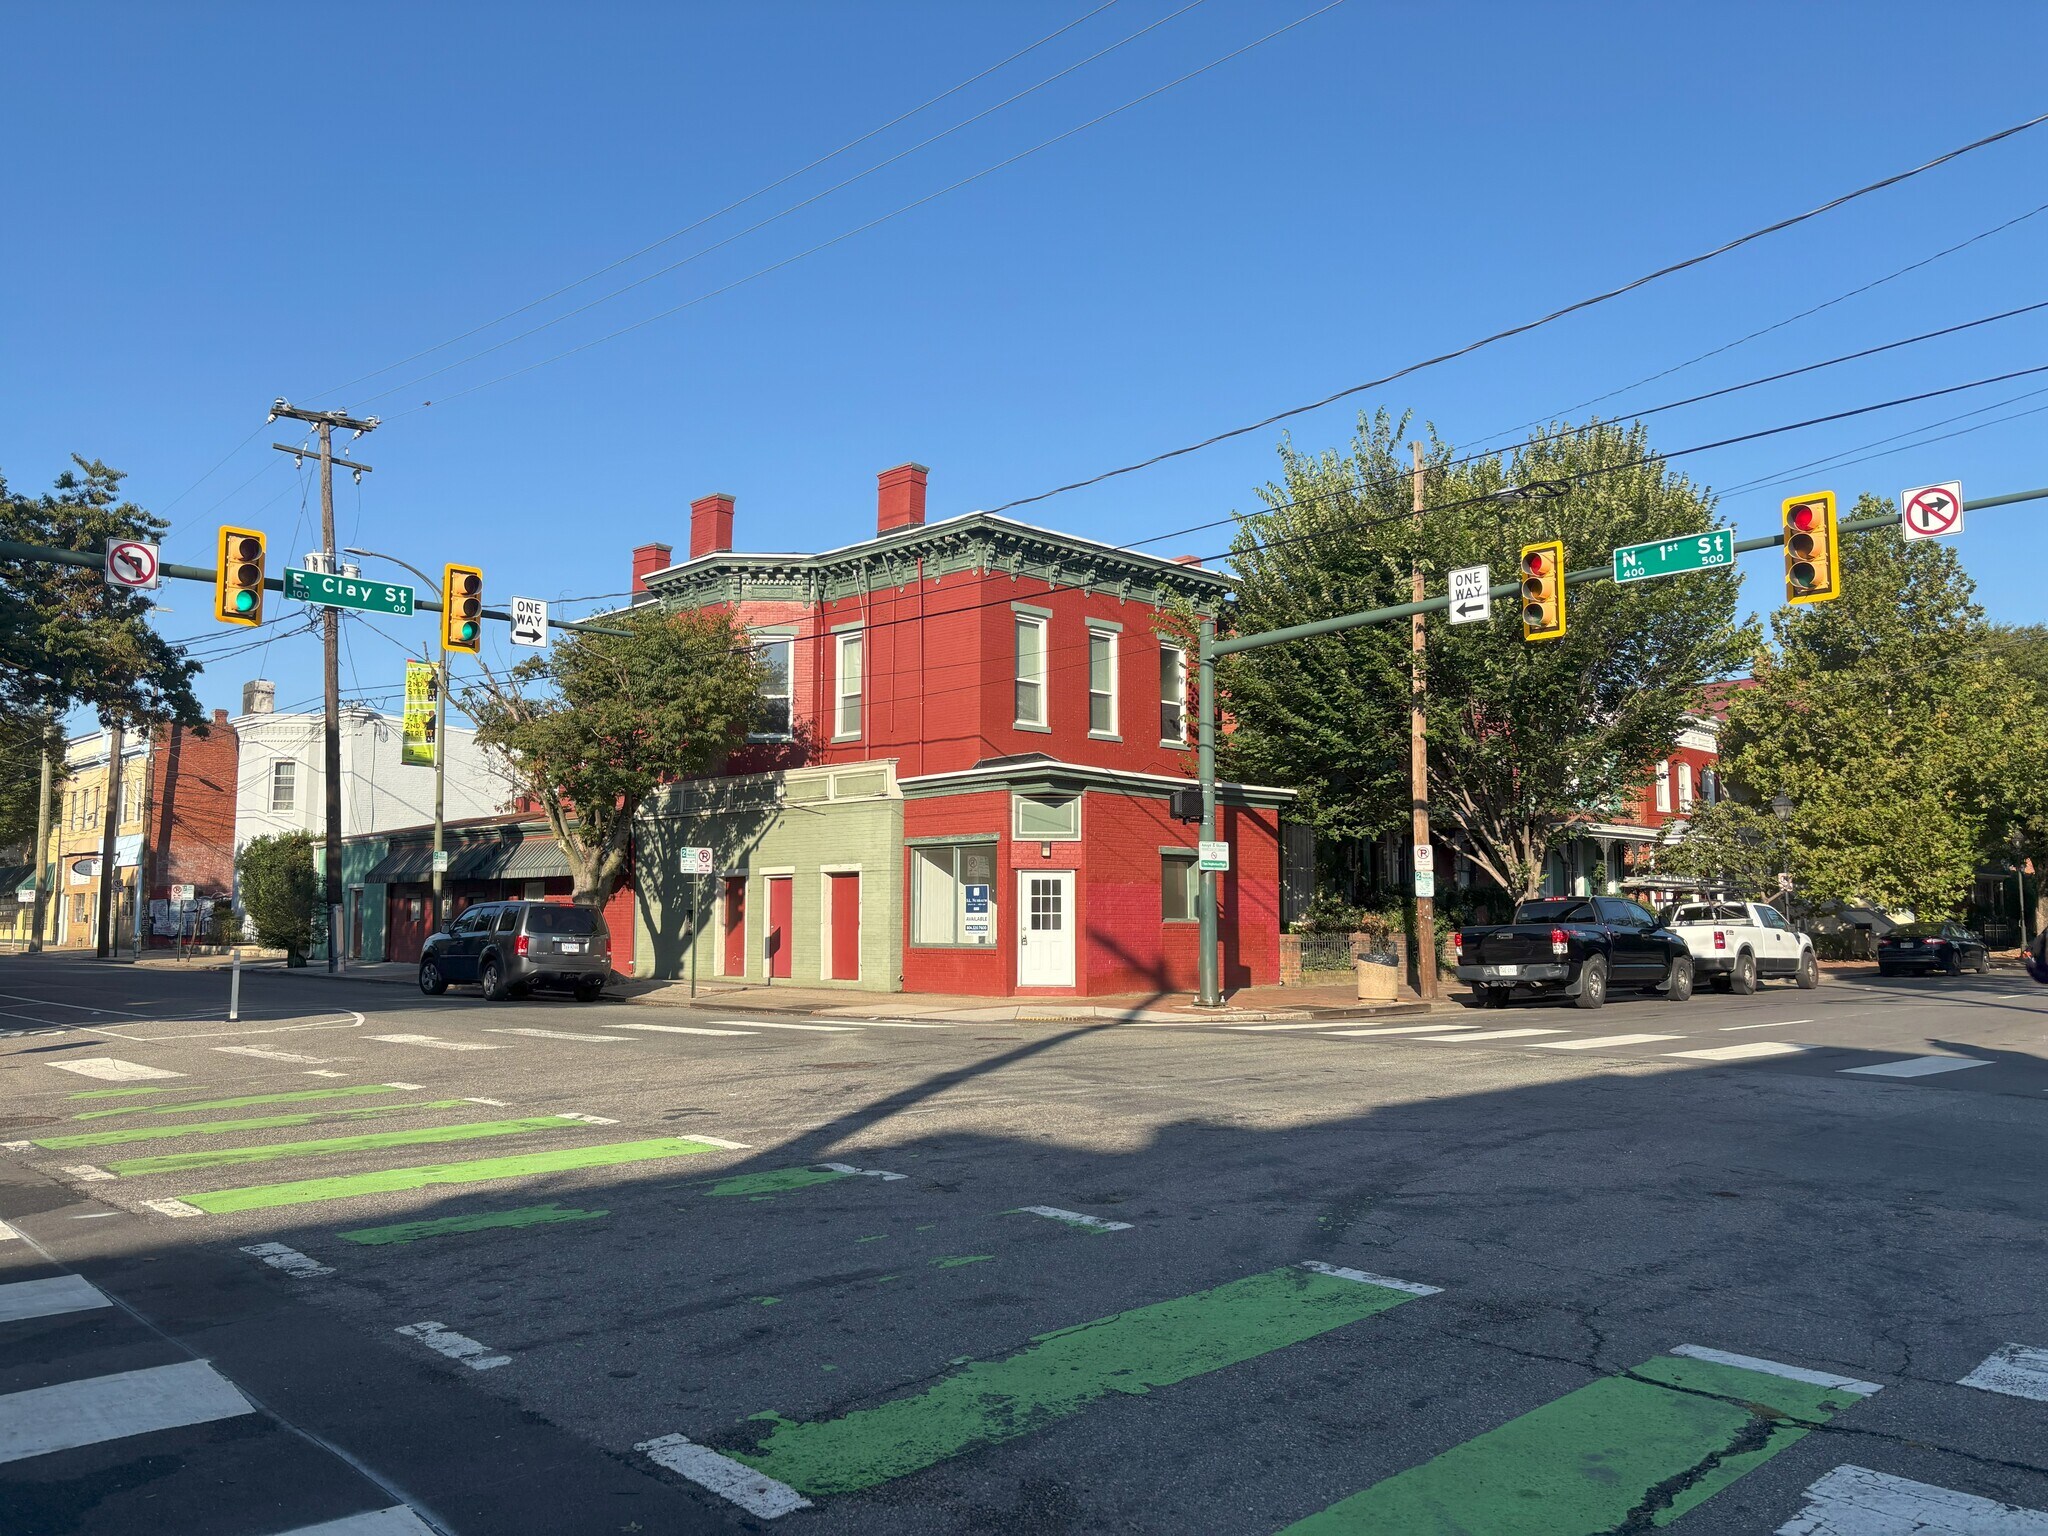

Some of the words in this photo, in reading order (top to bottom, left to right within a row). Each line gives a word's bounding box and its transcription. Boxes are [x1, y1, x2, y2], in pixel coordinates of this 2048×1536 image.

[1622, 550, 1642, 568] N.
[1659, 542, 1678, 561] 1st
[1697, 535, 1724, 554] St
[1623, 567, 1645, 578] 400
[1701, 553, 1724, 565] 500
[1455, 571, 1481, 587] ONE
[292, 572, 310, 589] E.
[322, 577, 373, 602] Clay
[384, 587, 407, 604] St
[1455, 584, 1483, 600] WAY
[292, 589, 310, 599] 100
[393, 604, 407, 613] 00
[517, 600, 542, 615] ONE
[516, 613, 543, 627] WAY
[407, 680, 423, 688] 2ND
[404, 722, 421, 730] 2ND
